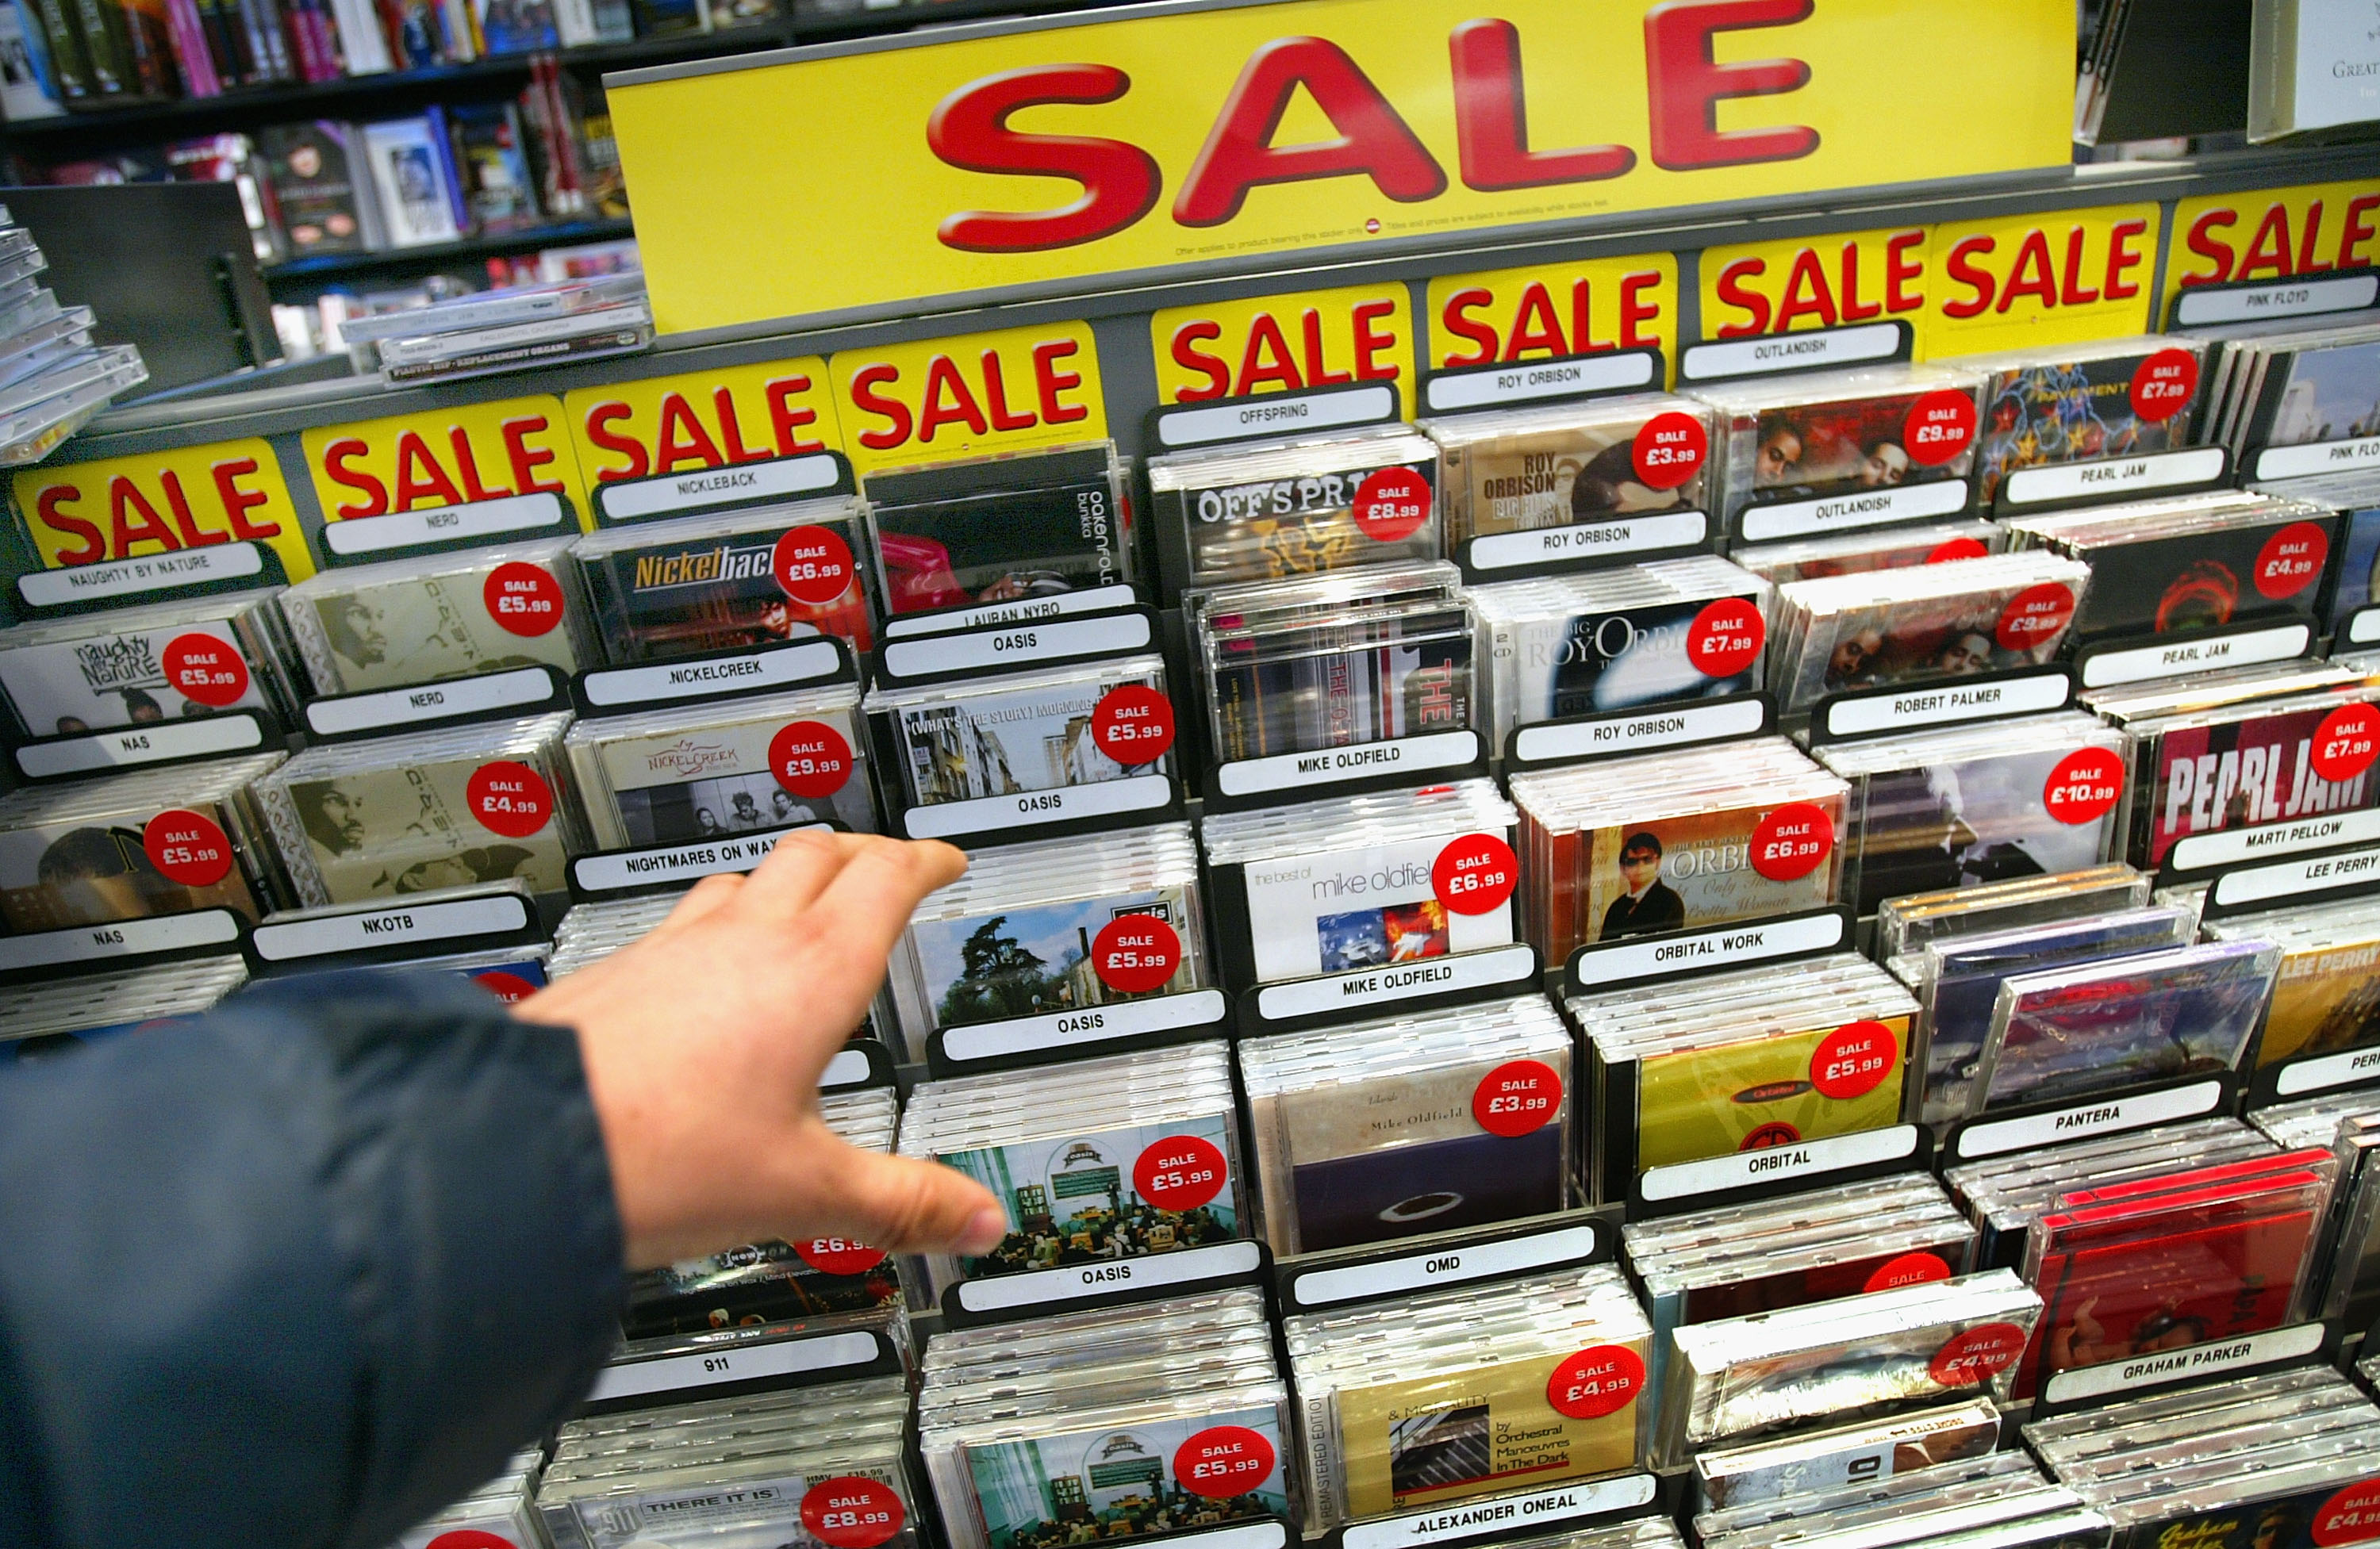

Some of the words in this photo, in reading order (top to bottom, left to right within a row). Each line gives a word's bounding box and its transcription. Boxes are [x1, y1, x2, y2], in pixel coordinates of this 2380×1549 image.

[927, 0, 1820, 254] SALE
[1238, 237, 1269, 250] product
[2181, 194, 2380, 287] SALE
[1943, 219, 2148, 317] SALE
[1717, 228, 1925, 339] SALE
[2246, 292, 2271, 308] PINK
[2275, 289, 2309, 306] FLOYD
[1443, 270, 1661, 367] SALE
[1171, 299, 1398, 403] SALE
[1755, 339, 1827, 360] OUTLANDISH
[1498, 374, 1522, 389] ROY
[1528, 367, 1581, 386] ORBISON
[2152, 365, 2181, 378] SALE
[850, 339, 1088, 449] SALE
[2142, 381, 2185, 400] £7.99
[1240, 404, 1308, 424] OFFSPRING
[1928, 408, 1957, 422] SALE
[585, 375, 825, 481] SALE
[1656, 431, 1687, 444] SALE
[1917, 424, 1964, 444] £9.99
[1524, 452, 1556, 474] ROY
[1646, 447, 1696, 466] £3.99
[2329, 446, 2354, 461] PINK
[324, 415, 565, 520] SALE
[2080, 468, 2117, 483] PEARL
[2123, 463, 2146, 478] JAM
[678, 472, 757, 495] NICKLEBACK
[1377, 486, 1410, 499] SALE
[1484, 474, 1555, 500] ORBISON
[37, 458, 281, 566] SALE
[1077, 492, 1092, 539] bunkka
[1368, 503, 1419, 520] £8.99
[1816, 497, 1891, 520] OUTLANDISH
[426, 512, 459, 529] NERD
[1544, 533, 1568, 550] ROY
[1576, 527, 1630, 546] ORBISON
[794, 546, 827, 560] SALE
[2279, 542, 2309, 555] SALE
[70, 566, 132, 589] NAUGHTY
[137, 562, 152, 578] BY
[157, 554, 210, 574] NATURE
[789, 562, 841, 582] £6.99
[2265, 558, 2312, 578] £4.99
[504, 581, 537, 592] SALE
[497, 596, 551, 613] £5.99
[1023, 602, 1061, 620] NYRO
[2025, 600, 2058, 614] SALE
[1568, 621, 1590, 635] BIG
[1712, 619, 1744, 632] SALE
[2009, 615, 2059, 633] £9.99
[993, 632, 1037, 652] OASIS
[1530, 634, 1595, 669] ROY
[1702, 635, 1752, 654] £7.99
[183, 654, 218, 665] SALE
[1494, 647, 1511, 659] CD
[2163, 647, 2200, 665] PEARL
[2205, 643, 2230, 659] JAM
[180, 669, 236, 685] £5.99
[1420, 658, 1453, 724] THE
[409, 692, 444, 710] NERD
[1894, 695, 1946, 714] ROBERT
[1951, 688, 2002, 707] PALMER
[965, 712, 988, 727] THE
[991, 706, 1033, 724] STORY)
[1037, 698, 1094, 718] MORNING
[1115, 706, 1150, 719] SALE
[1107, 723, 1163, 742] £5.99
[1594, 725, 1621, 741] ROY
[1627, 718, 1685, 738] ORBISON
[2336, 722, 2365, 737] SALE
[121, 736, 151, 751] NAS
[792, 741, 825, 754] SALE
[2324, 740, 2371, 759] £7.99
[785, 758, 841, 776] £9.99
[1298, 755, 1330, 773] MIKE
[1336, 746, 1400, 769] OLDFIELD
[2069, 768, 2102, 782] SALE
[489, 781, 524, 792] SALE
[2050, 784, 2115, 804] £10.99
[2163, 744, 2282, 835] PEARL
[482, 796, 538, 814] £4.99
[1019, 794, 1062, 813] OASIS
[165, 830, 199, 844] SALE
[1776, 823, 1810, 838] SALE
[2246, 830, 2286, 848] MARTI
[2290, 821, 2343, 840] PELLOW
[162, 845, 218, 865] £5.99
[626, 849, 716, 873] NIGHTMARES
[721, 844, 742, 861] ON
[747, 838, 778, 857] WAX
[1764, 842, 1819, 861] £6.99
[1456, 853, 1491, 870] SALE
[2305, 862, 2331, 880] LEE
[2335, 855, 2378, 875] PERRY
[1255, 872, 1273, 885] the
[1274, 868, 1299, 883] best
[1313, 872, 1367, 899] mike
[1371, 860, 1433, 889] oldfiel
[1449, 872, 1506, 895] £6.99
[362, 914, 414, 935] NKOTB
[94, 928, 125, 947] NAS
[1117, 935, 1154, 947] SALE
[1655, 941, 1714, 961] ORBITAL
[1722, 933, 1764, 951] WORK
[1107, 952, 1166, 969] £5.99
[1343, 976, 1378, 996] MIKE
[1384, 966, 1452, 990] OLDFIELD
[1058, 1014, 1104, 1033] OASIS
[1837, 1040, 1872, 1057] SALE
[1825, 1056, 1883, 1081] £5.99
[1501, 1079, 1538, 1092] SALE
[1488, 1095, 1548, 1114] £3.99
[1372, 1119, 1403, 1132] Mike
[1408, 1108, 1463, 1125] Oldfield
[2055, 1106, 2121, 1130] PANTERA
[1157, 1153, 1196, 1169] SALE
[1749, 1150, 1811, 1174] ORBITAL
[1151, 1169, 1213, 1191] £5.99
[1425, 1255, 1461, 1275] OMD
[1081, 1266, 1131, 1285] OASIS
[1888, 1271, 1925, 1286] SALE
[1963, 1338, 2002, 1354] SALE
[704, 1357, 730, 1372] 911
[1945, 1353, 2007, 1372] £4.99
[2124, 1355, 2188, 1380] GRAHAM
[2192, 1343, 2252, 1365] PARKER
[1576, 1362, 1615, 1381] SALE
[1566, 1376, 1630, 1402] £4.99
[1388, 1408, 1400, 1421] &
[1496, 1421, 1511, 1433] by
[1496, 1424, 1563, 1444] Orchestral
[1201, 1443, 1243, 1458] SALE
[1192, 1459, 1260, 1478] £5.99
[1496, 1459, 1508, 1472] In
[1510, 1455, 1534, 1469] The
[1537, 1451, 1569, 1467] Dark
[806, 1474, 832, 1483] HMV
[1316, 1446, 1332, 1518] REMASTERED
[647, 1496, 712, 1513] THERE
[725, 1492, 746, 1503] IT
[752, 1490, 774, 1501] IS
[828, 1494, 871, 1509] SALE
[600, 1506, 636, 1534] 911
[822, 1510, 889, 1529] £8.99
[1416, 1504, 1515, 1534] ALEXANDER
[1522, 1494, 1577, 1515] ONEAL
